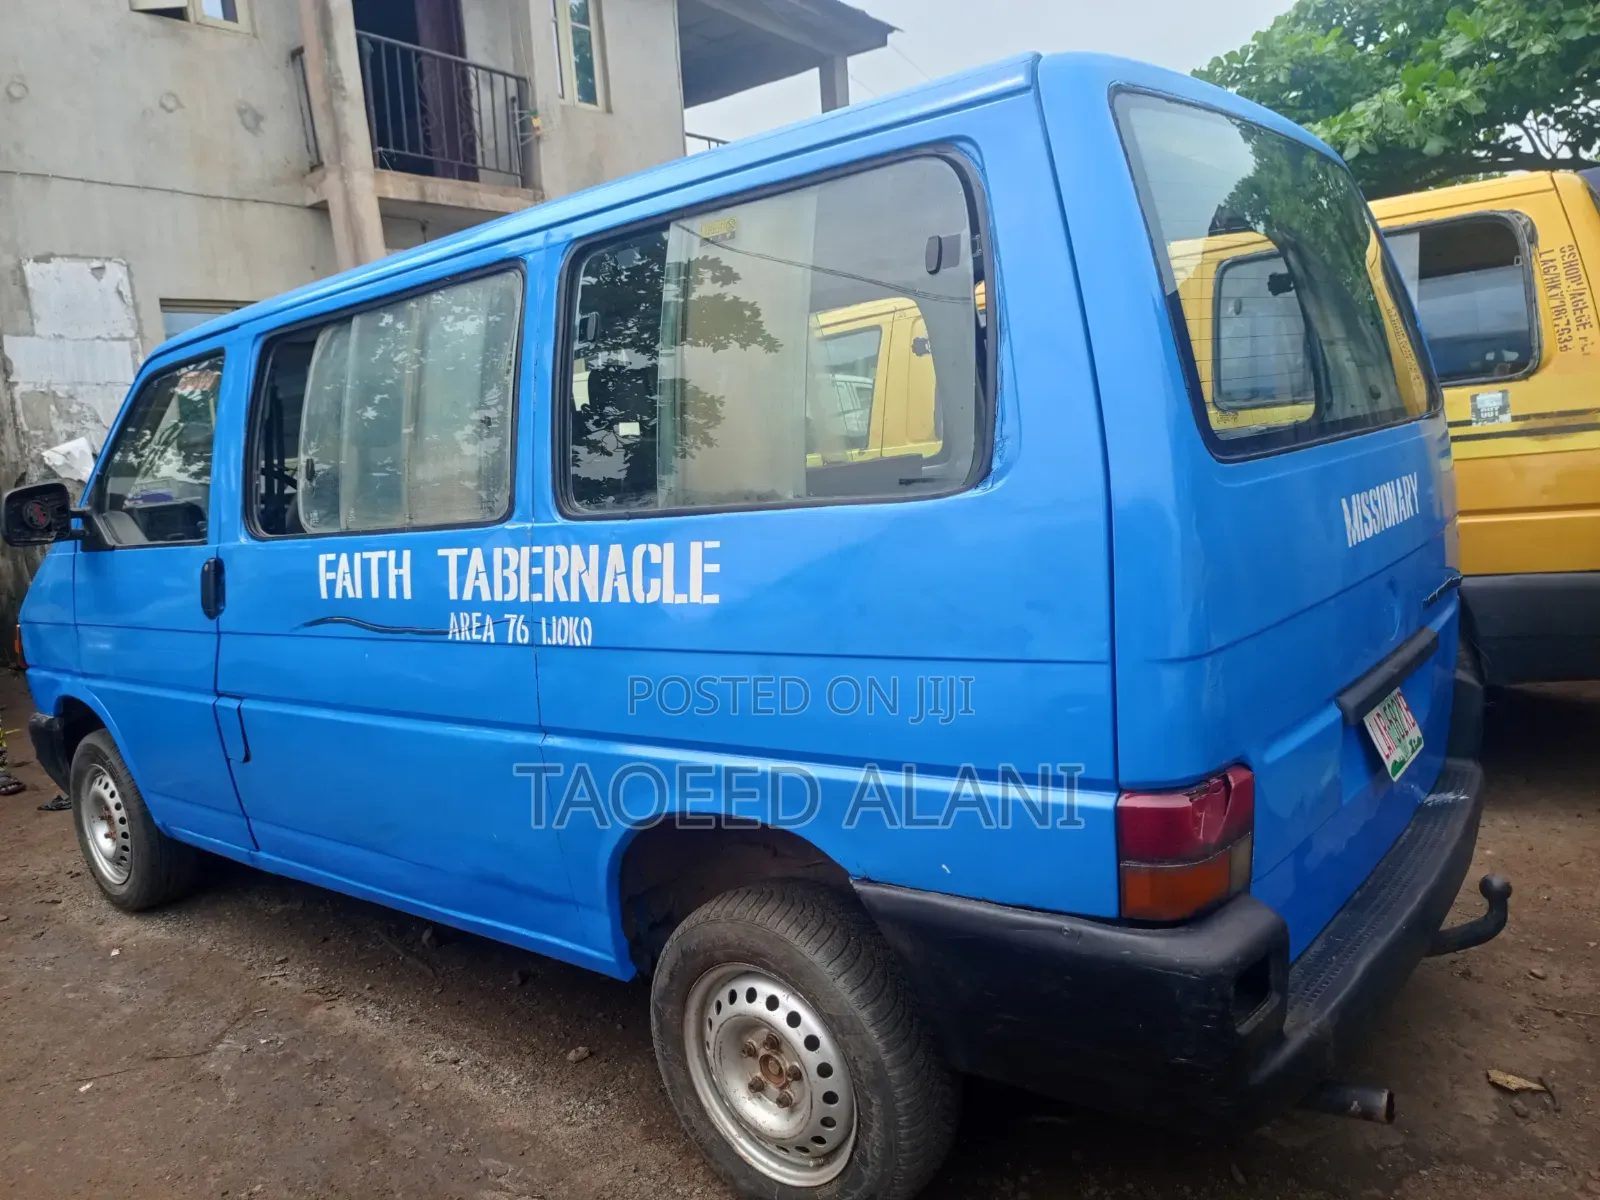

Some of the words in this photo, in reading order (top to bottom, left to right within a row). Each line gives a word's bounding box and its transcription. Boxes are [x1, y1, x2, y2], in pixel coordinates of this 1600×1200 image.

[1341, 472, 1419, 547] MISSIONARY
[318, 550, 412, 600] FAITH
[438, 541, 721, 605] TABERNACLE
[448, 612, 495, 643] AREA
[504, 613, 529, 644] 76
[541, 615, 592, 646] IJOKO
